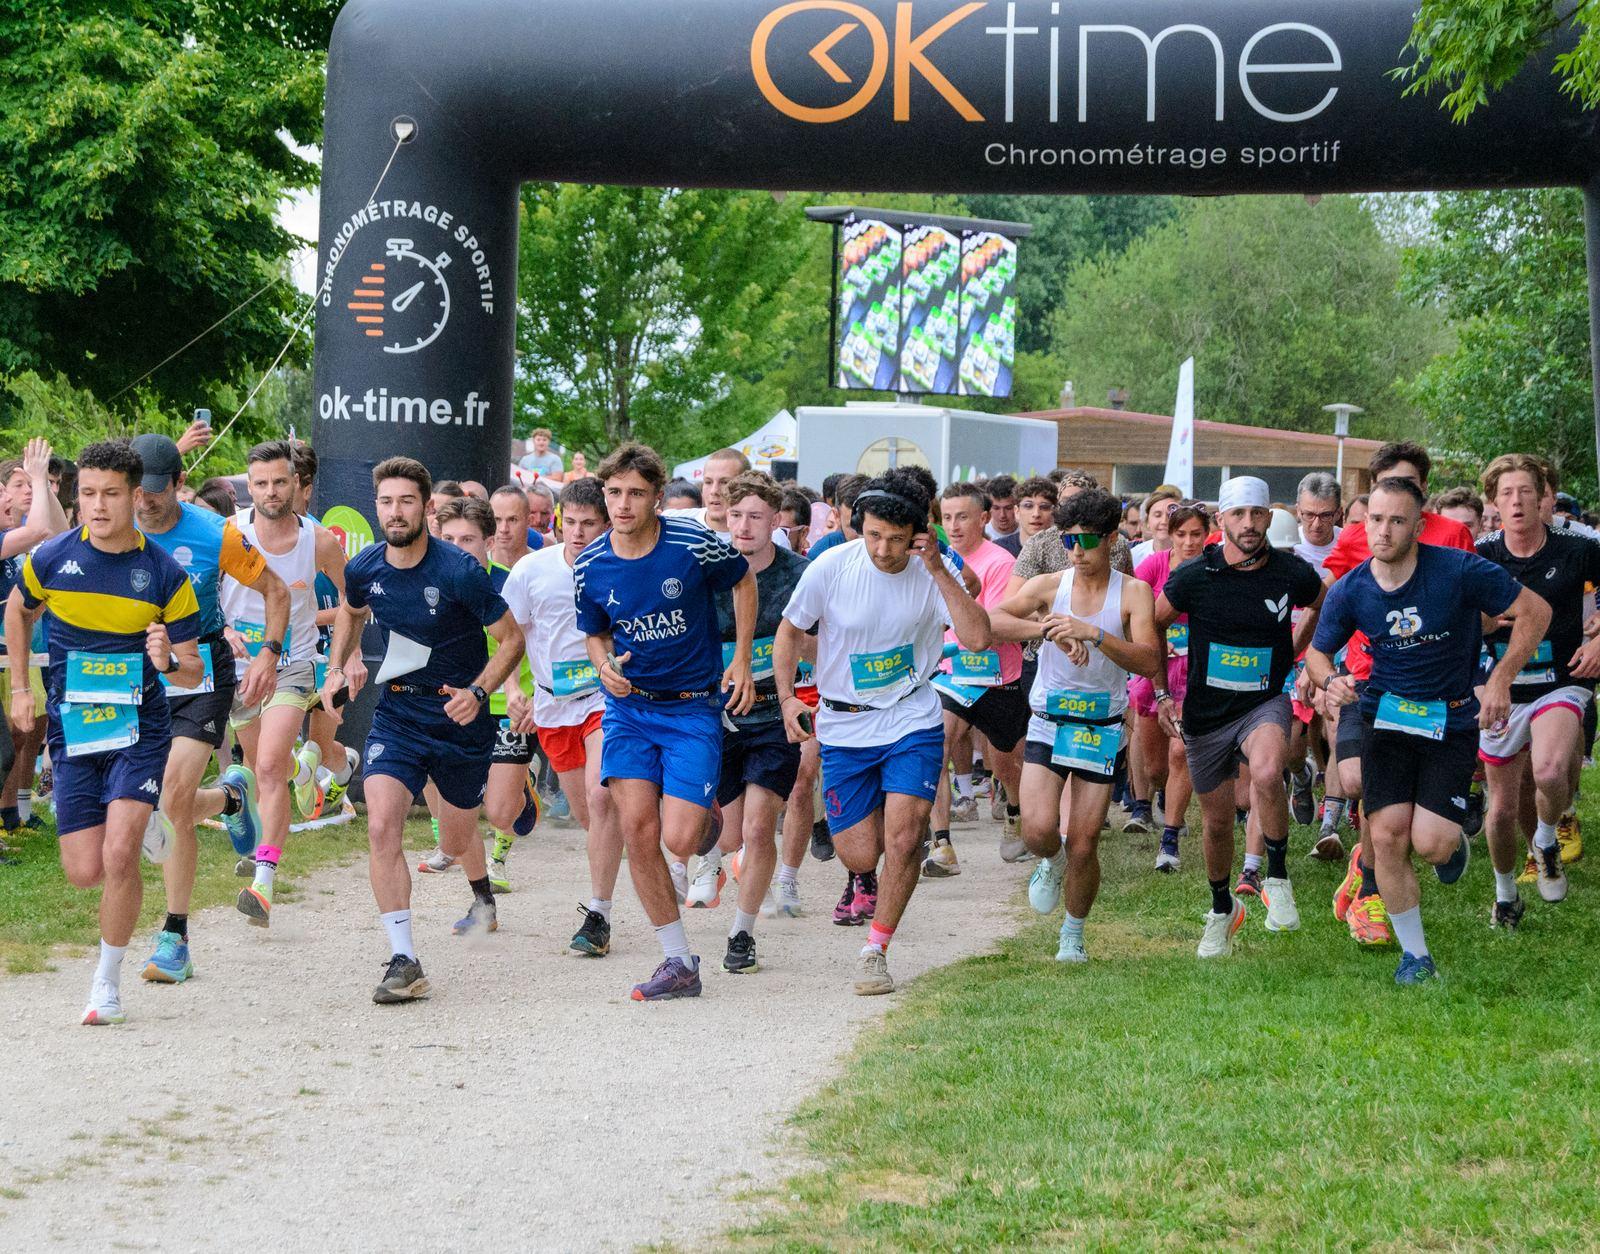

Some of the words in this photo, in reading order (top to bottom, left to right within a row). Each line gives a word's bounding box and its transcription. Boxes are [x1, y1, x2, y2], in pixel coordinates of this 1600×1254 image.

[751, 0, 1342, 122] OKtime
[984, 142, 1227, 168] Chronométrage
[1240, 140, 1341, 168] sportif
[322, 199, 454, 307] CHRONOMÉTRAGE
[454, 224, 495, 315] SPORTIF
[319, 386, 490, 427] ok-time.fr
[616, 609, 686, 634] QATAR
[1386, 606, 1423, 636] 25
[633, 622, 687, 642] AIRWAYS
[755, 643, 774, 657] 12
[81, 661, 128, 676] 2283
[865, 653, 902, 673] 1992
[961, 655, 989, 666] 1271
[1220, 653, 1258, 667] 2291
[1058, 697, 1096, 712] 2081
[1398, 700, 1428, 716] 252
[82, 706, 117, 724] 228
[1072, 730, 1102, 747] 208
